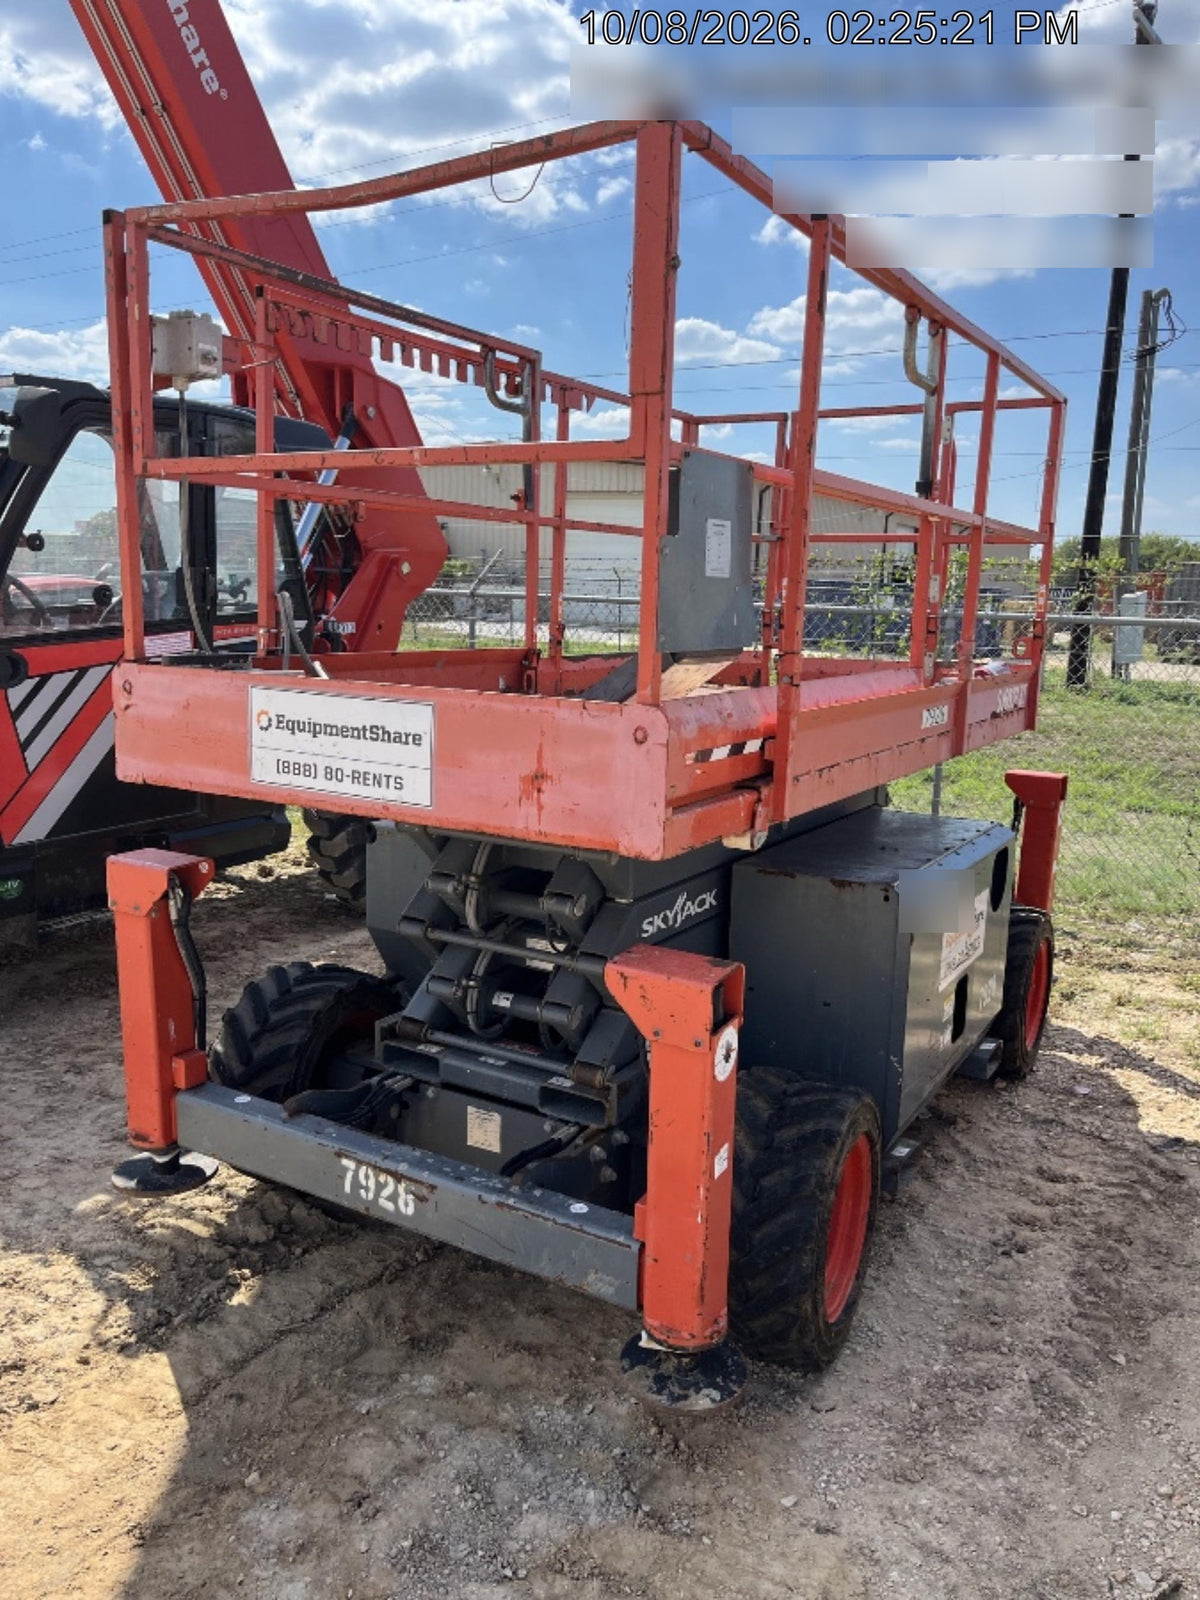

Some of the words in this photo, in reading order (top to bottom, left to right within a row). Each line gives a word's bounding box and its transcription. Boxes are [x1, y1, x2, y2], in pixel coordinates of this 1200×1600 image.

[275, 714, 423, 747] EquipmentShare
[276, 758, 318, 780] (888)
[324, 766, 404, 791] 80-RENTS
[641, 888, 718, 938] SKYJACK
[341, 1157, 415, 1216] 7926
